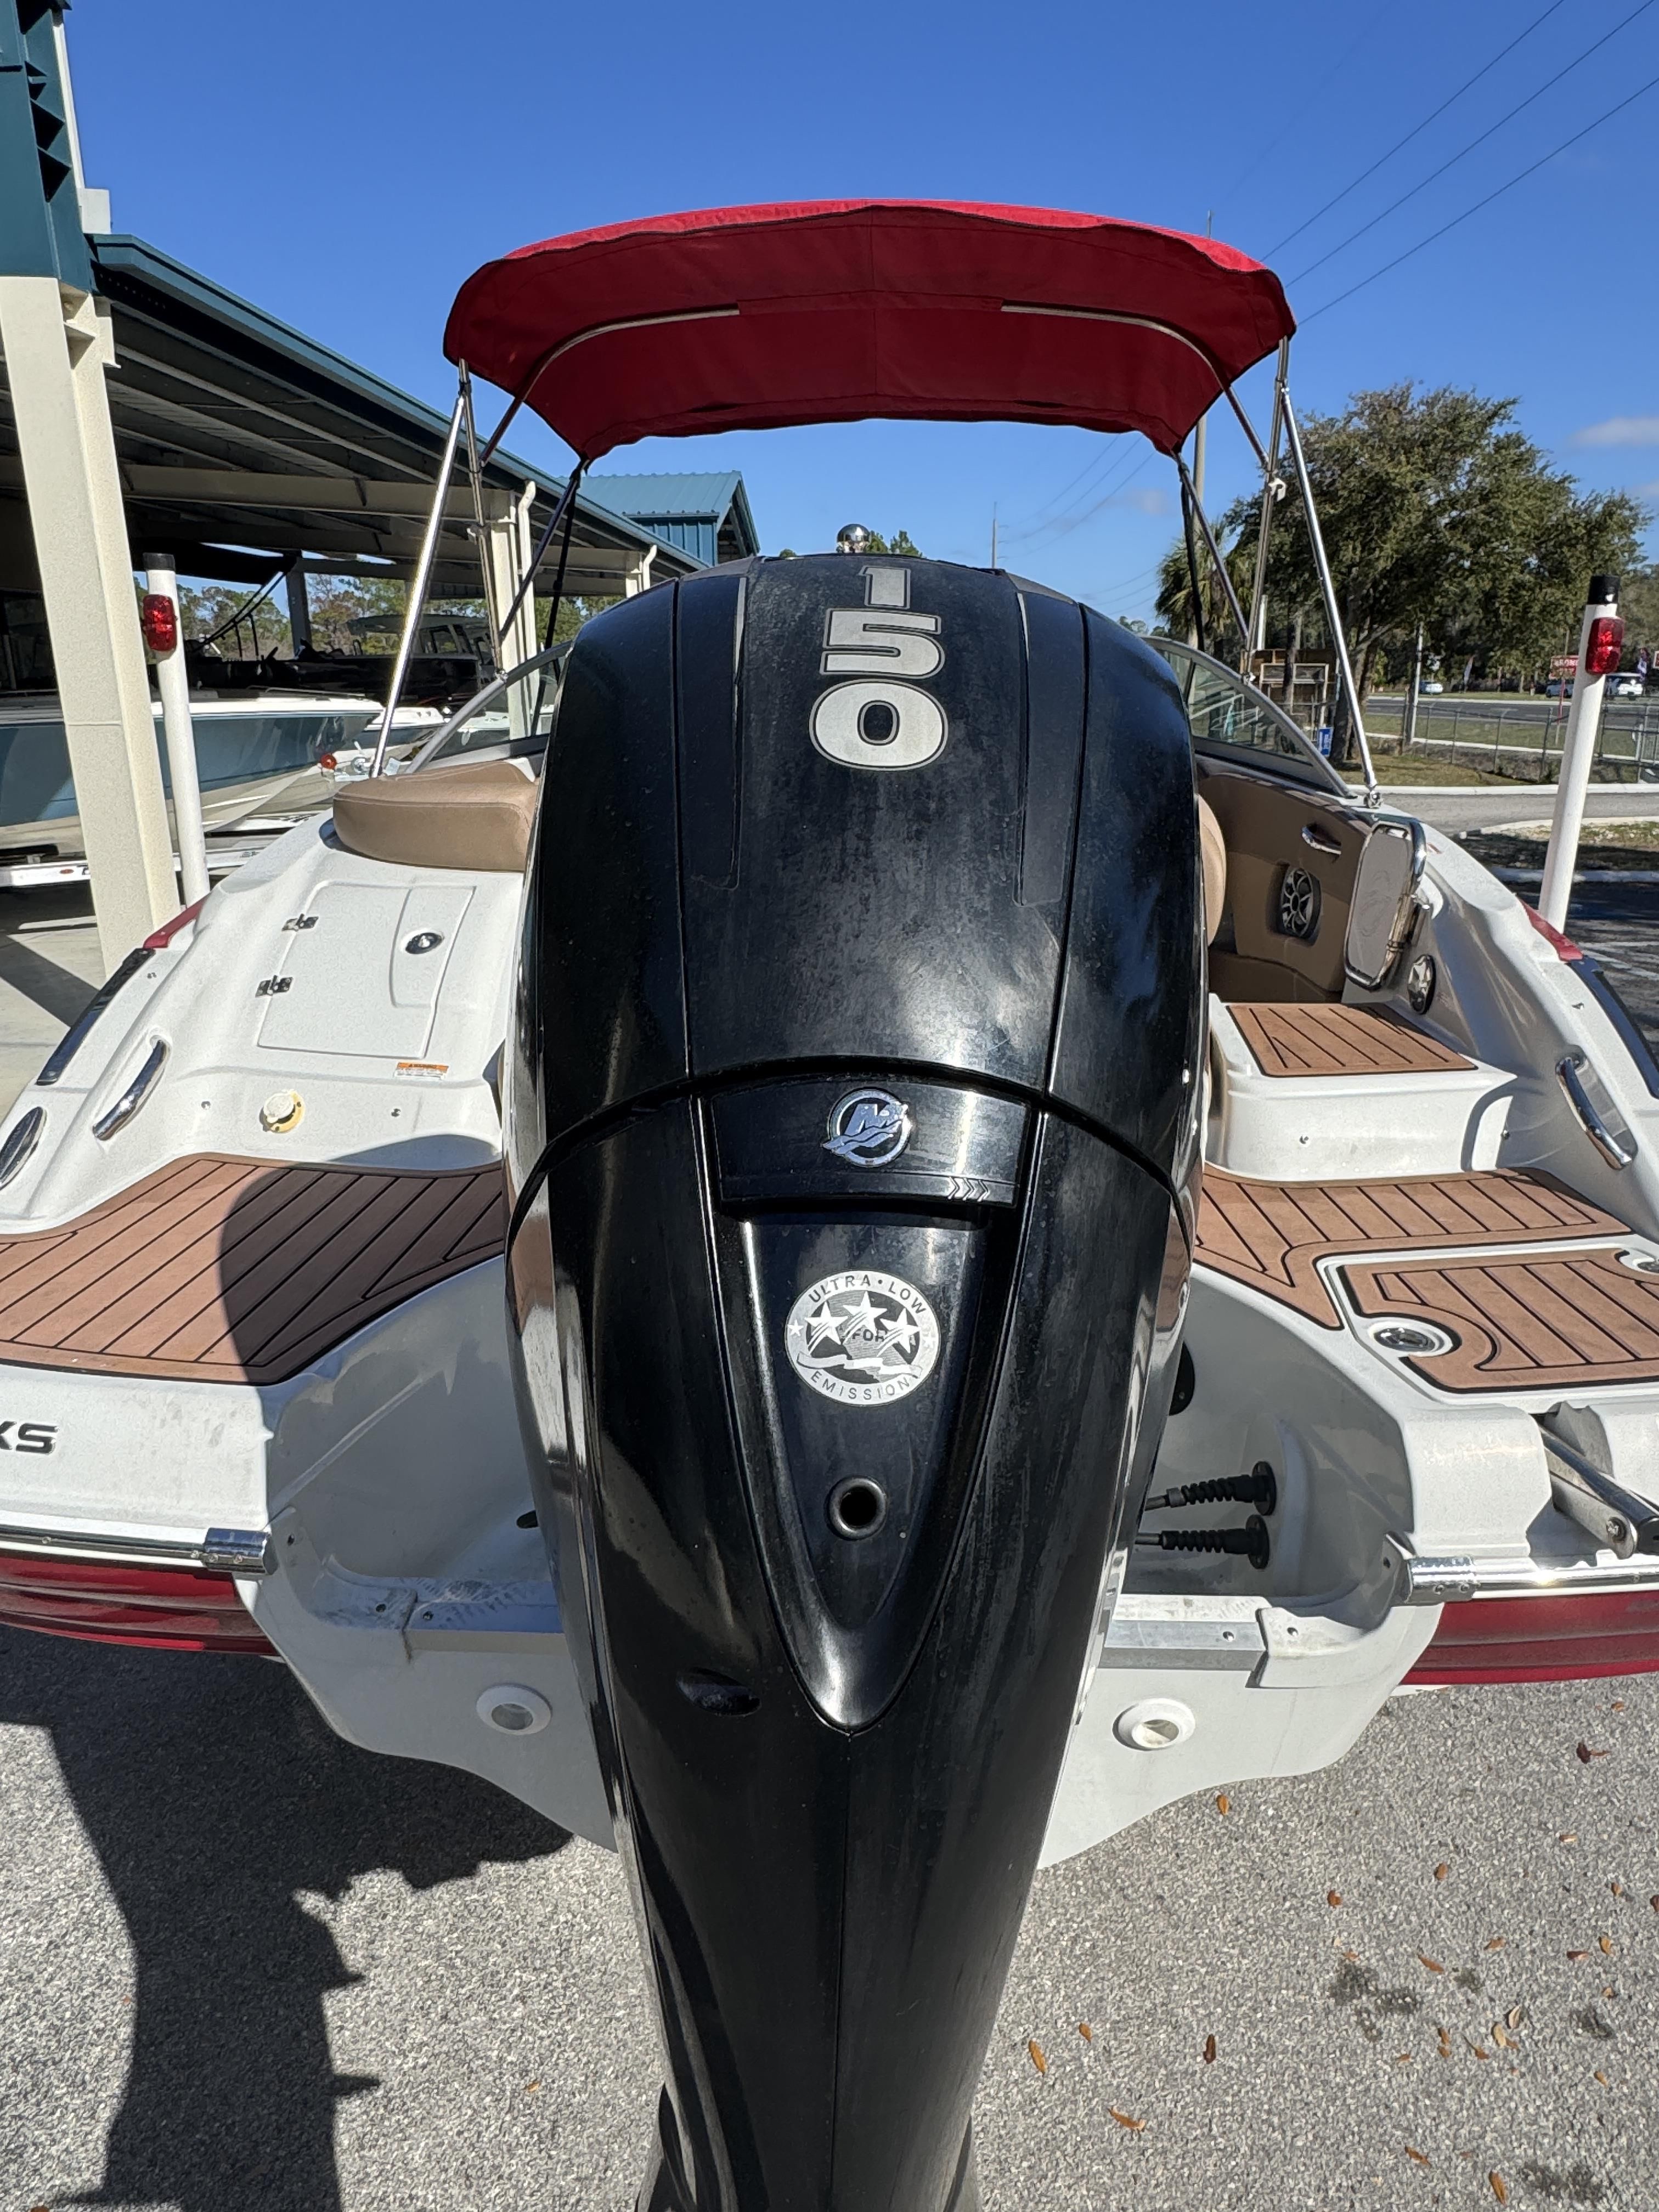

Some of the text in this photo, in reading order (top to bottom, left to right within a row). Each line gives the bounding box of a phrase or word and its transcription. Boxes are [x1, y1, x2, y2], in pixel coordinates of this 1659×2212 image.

[809, 565, 948, 771] 150
[809, 1274, 928, 1314] ULTRA LOW
[810, 1370, 911, 1401] EMISSION
